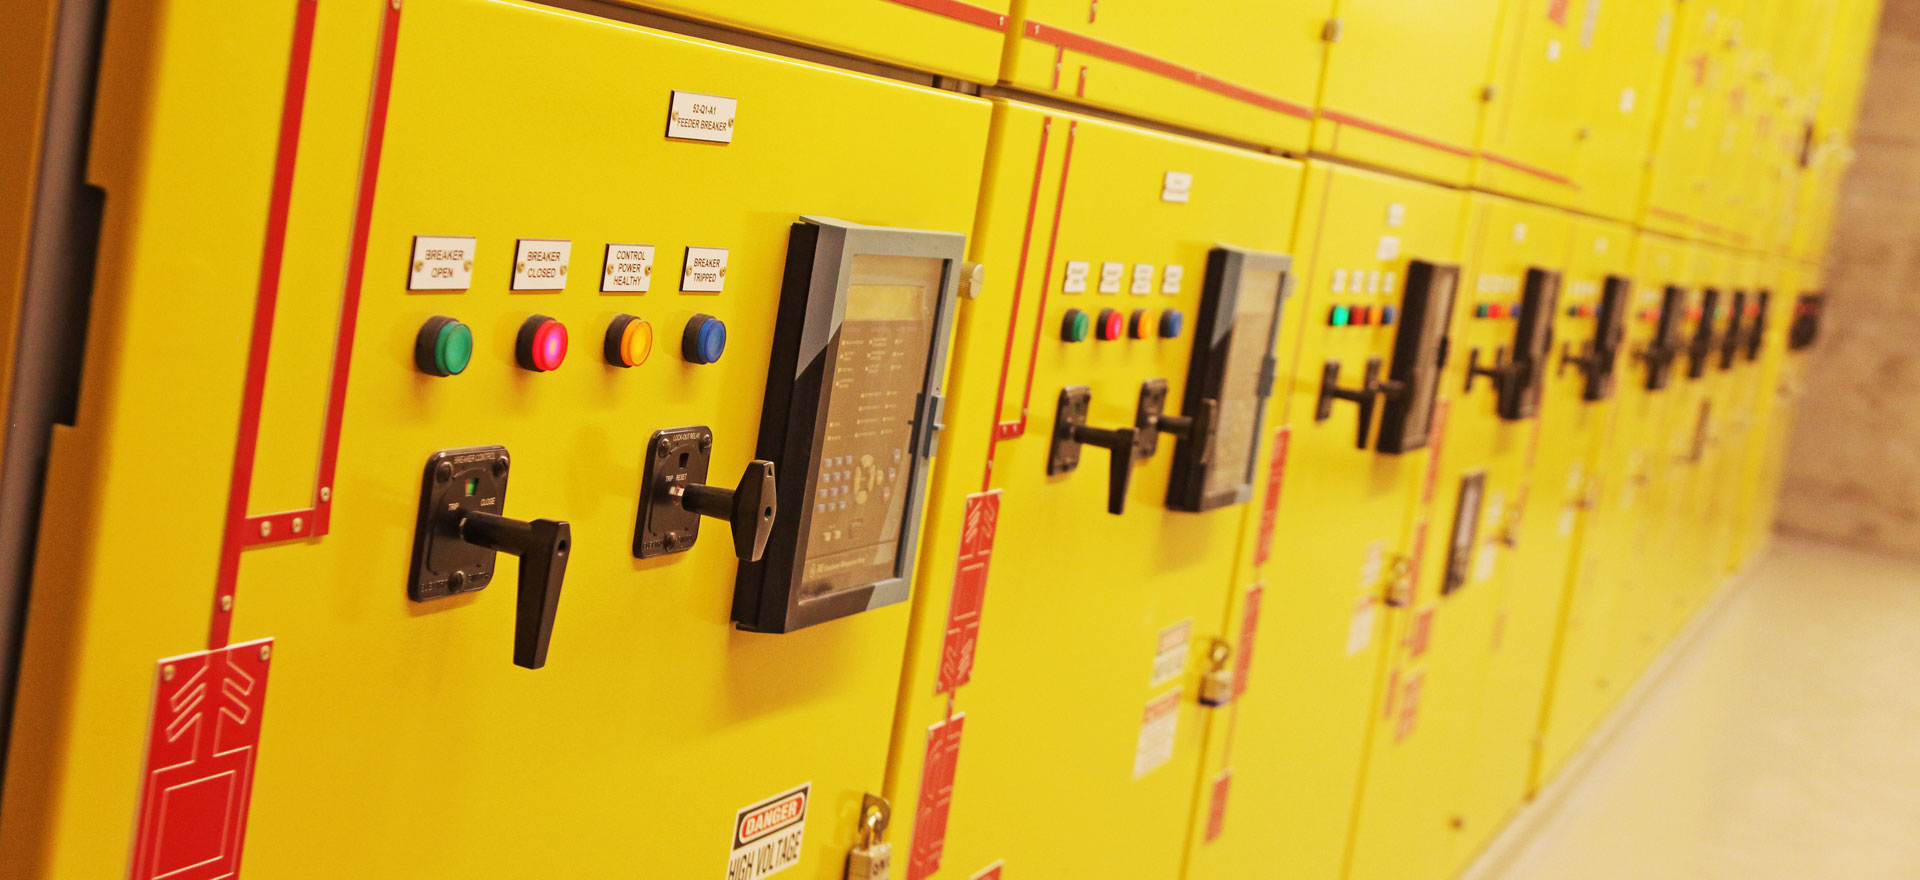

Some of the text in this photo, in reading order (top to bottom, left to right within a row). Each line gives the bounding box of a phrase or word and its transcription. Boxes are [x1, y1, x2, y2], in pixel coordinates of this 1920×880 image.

[692, 103, 717, 115] 52-Q1-A1
[677, 117, 727, 131] FEEDER BREAKER
[425, 249, 464, 261] BREAKER
[527, 251, 561, 261] BREAKER
[616, 250, 646, 261] CONTROL
[618, 263, 641, 273] POWER
[693, 257, 721, 268] BREAKER
[431, 267, 453, 279] OPEN
[527, 268, 556, 278] CLOSED
[693, 272, 717, 283] TRIPPED
[613, 275, 642, 286] HEALTHY
[665, 472, 688, 483] TRIP RESET
[448, 502, 459, 511] TRIP
[480, 497, 496, 507] CLOSE
[745, 800, 799, 836] DANGER
[728, 830, 802, 880] HIGH VOLTAGE
